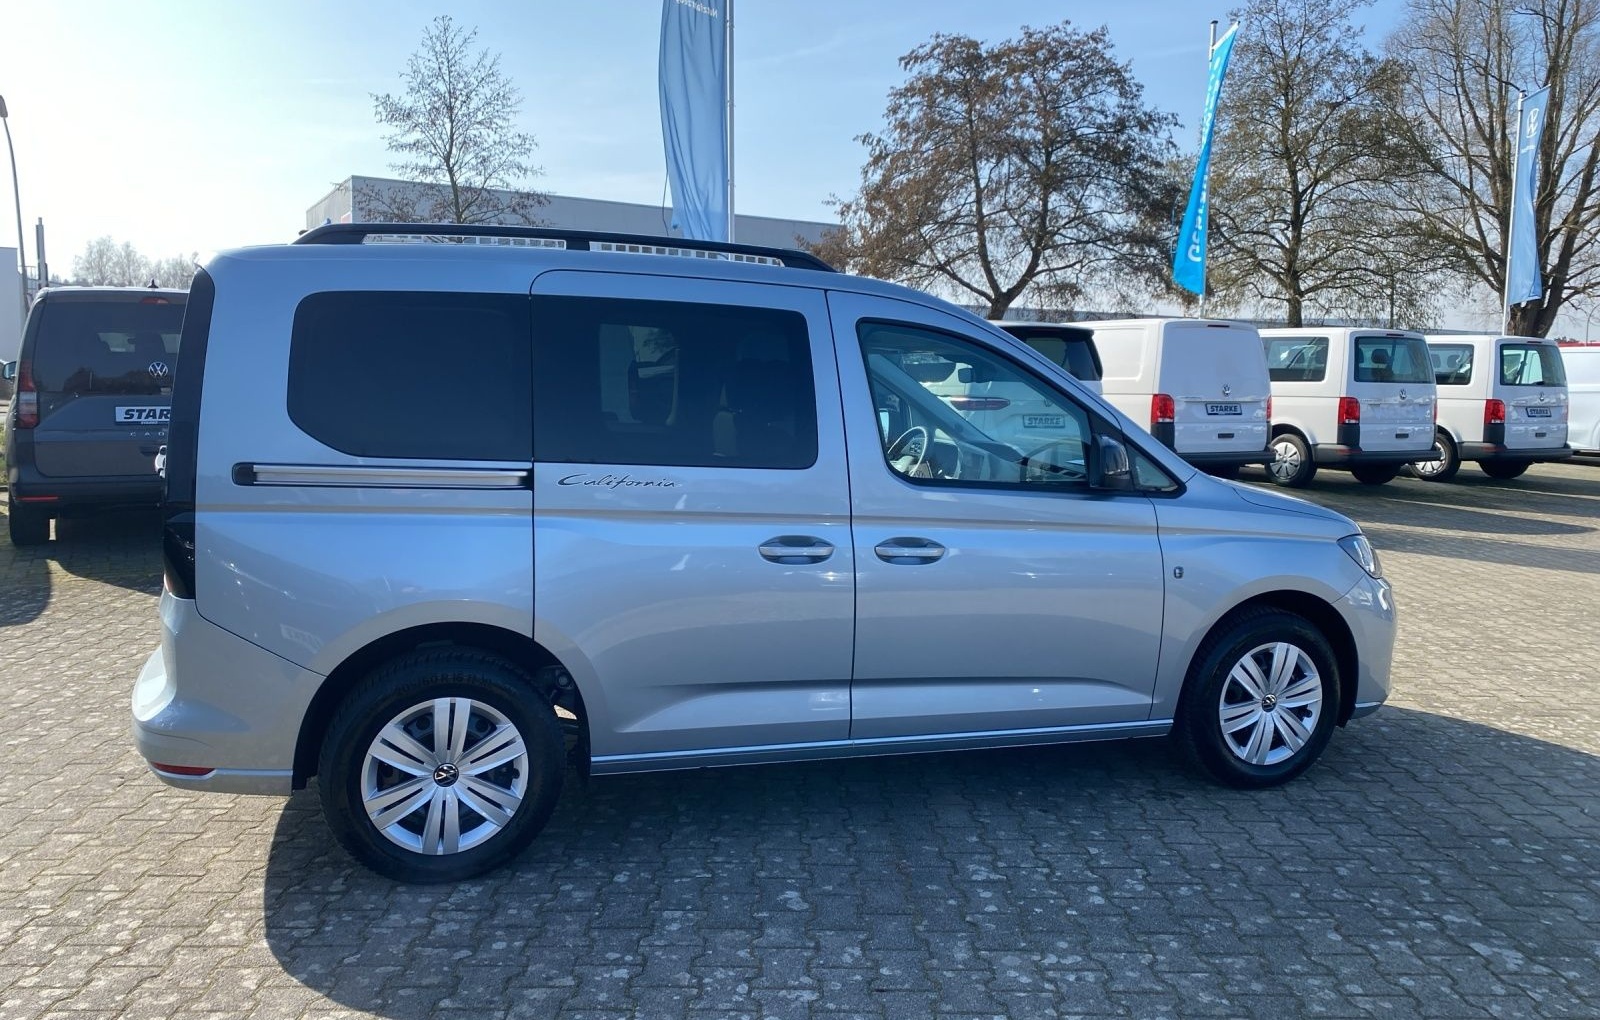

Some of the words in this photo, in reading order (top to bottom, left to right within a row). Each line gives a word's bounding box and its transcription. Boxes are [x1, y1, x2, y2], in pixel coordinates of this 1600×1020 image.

[1210, 405, 1239, 413] STARKE
[1027, 416, 1061, 426] STARKE
[557, 473, 676, 490] California
